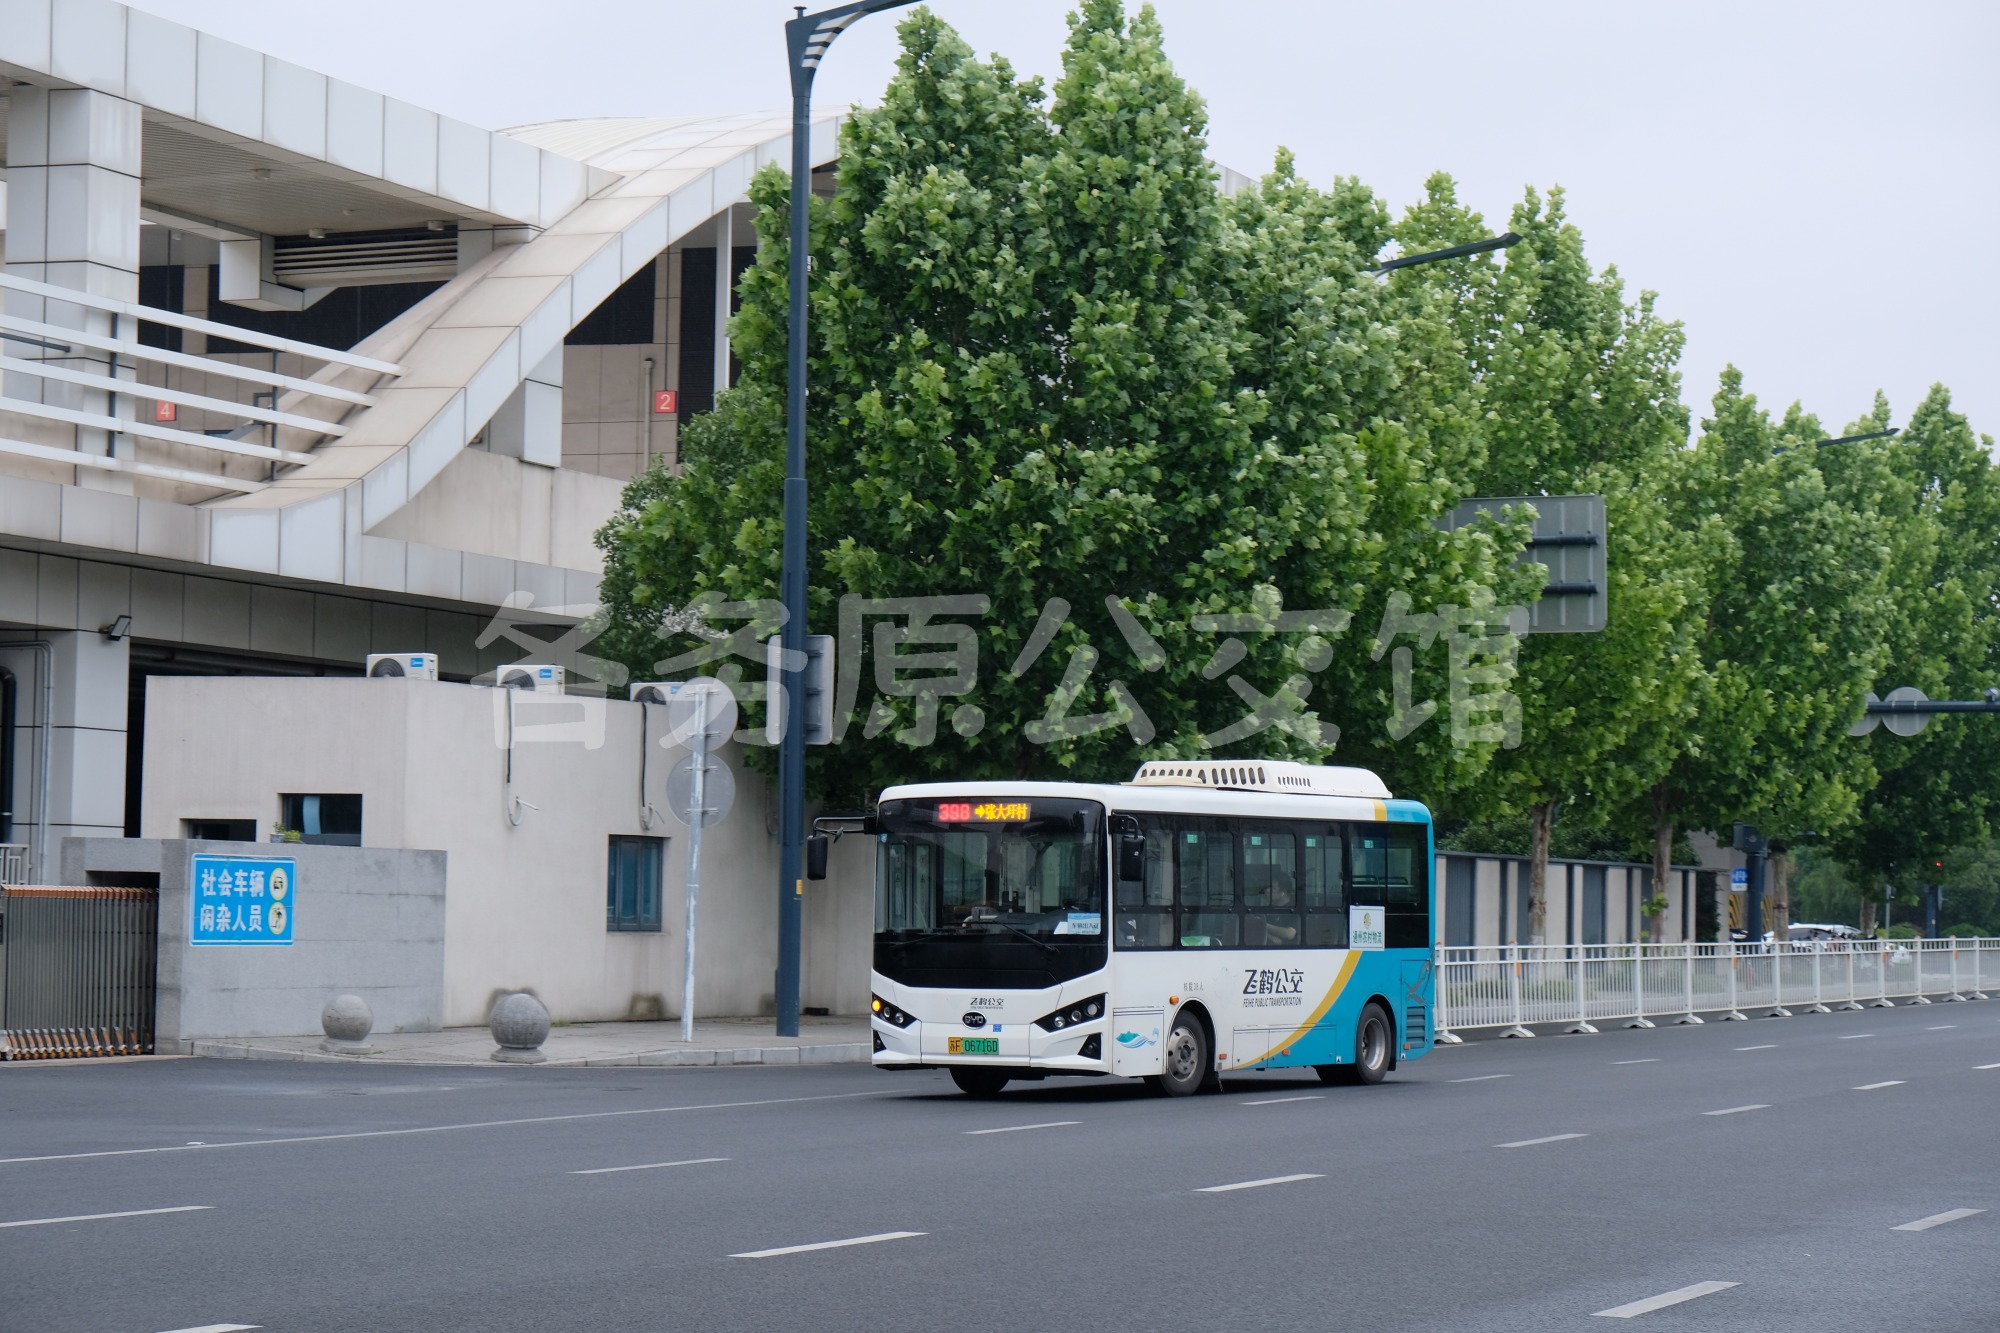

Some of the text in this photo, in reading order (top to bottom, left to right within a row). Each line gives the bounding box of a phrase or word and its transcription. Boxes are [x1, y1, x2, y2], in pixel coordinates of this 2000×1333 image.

[160, 402, 171, 418] 4
[660, 394, 671, 410] 2
[939, 803, 970, 821] 398
[201, 868, 265, 898] 社会车辆
[200, 903, 262, 932] 闲杂人员
[1243, 968, 1304, 994] 飞鹤公交
[970, 997, 1004, 1006] 飞鹤公交
[964, 1015, 984, 1024] BYD
